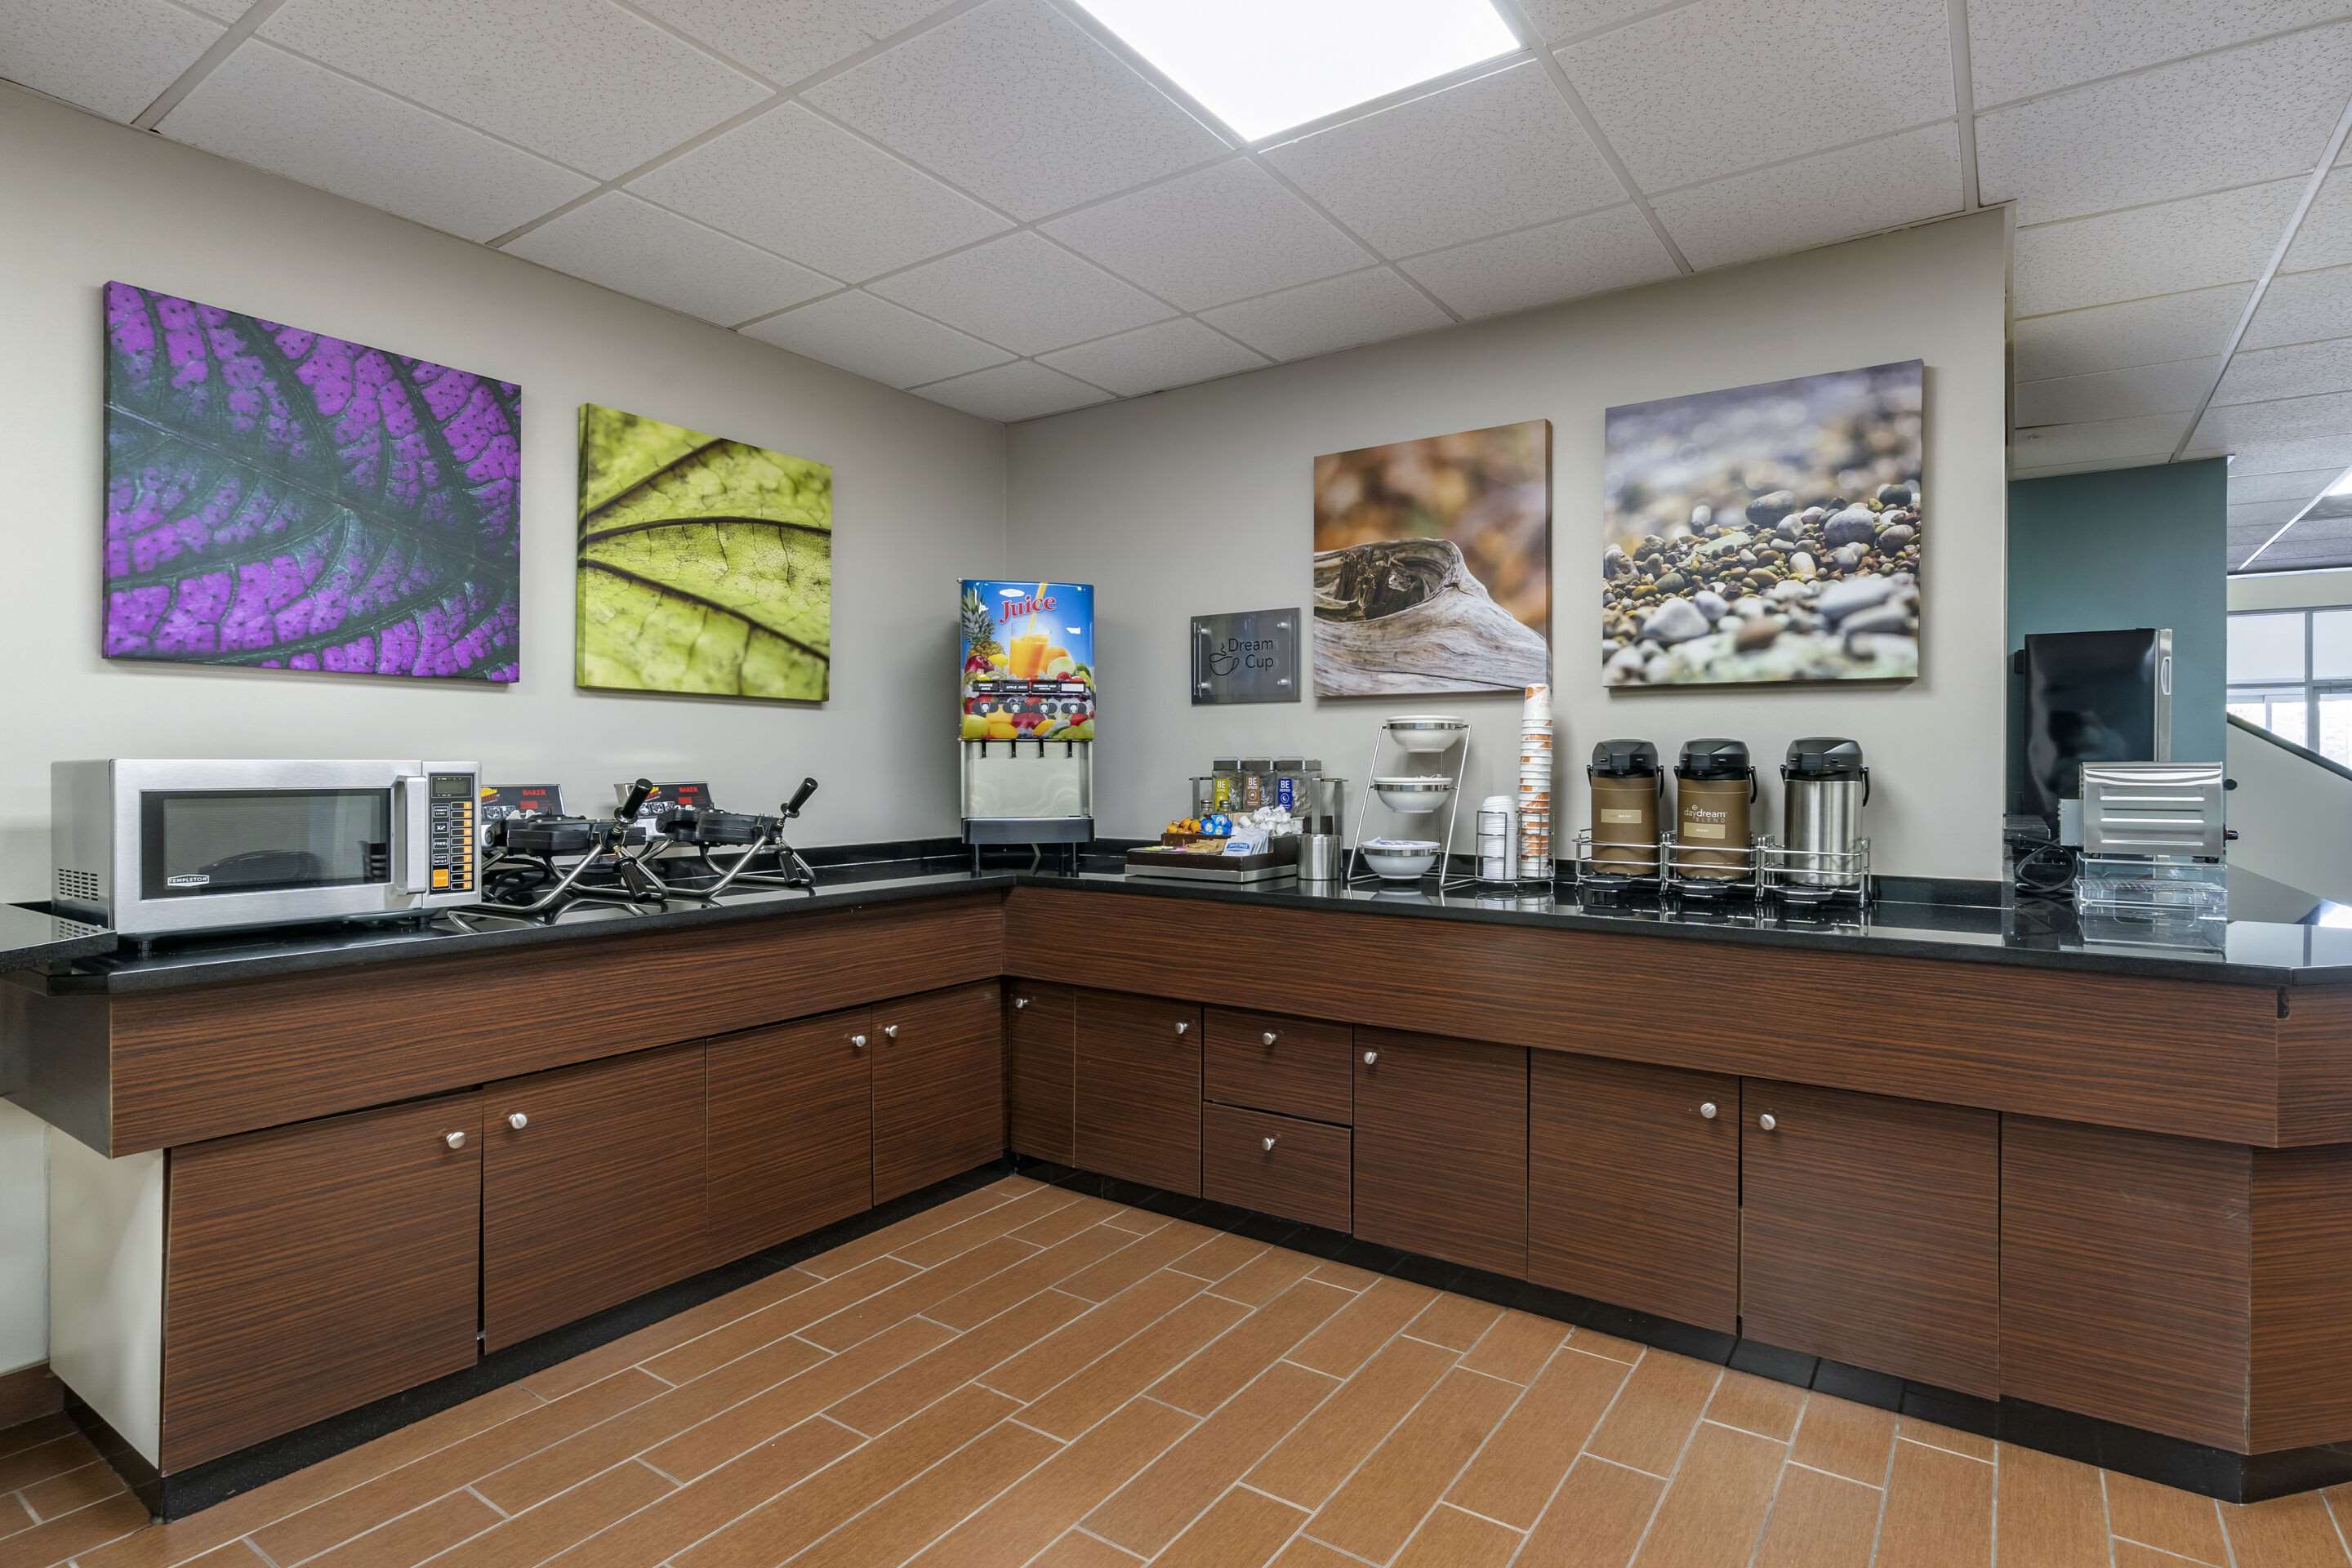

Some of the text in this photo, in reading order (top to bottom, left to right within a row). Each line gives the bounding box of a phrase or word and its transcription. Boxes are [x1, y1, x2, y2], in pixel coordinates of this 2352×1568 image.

[999, 595, 1057, 624] Juice
[1228, 638, 1273, 653] Dream
[1245, 654, 1274, 672] Cup
[1217, 781, 1226, 789] BE
[1248, 777, 1258, 786] BE
[1281, 780, 1290, 789] BE
[1684, 808, 1726, 819] daydream
